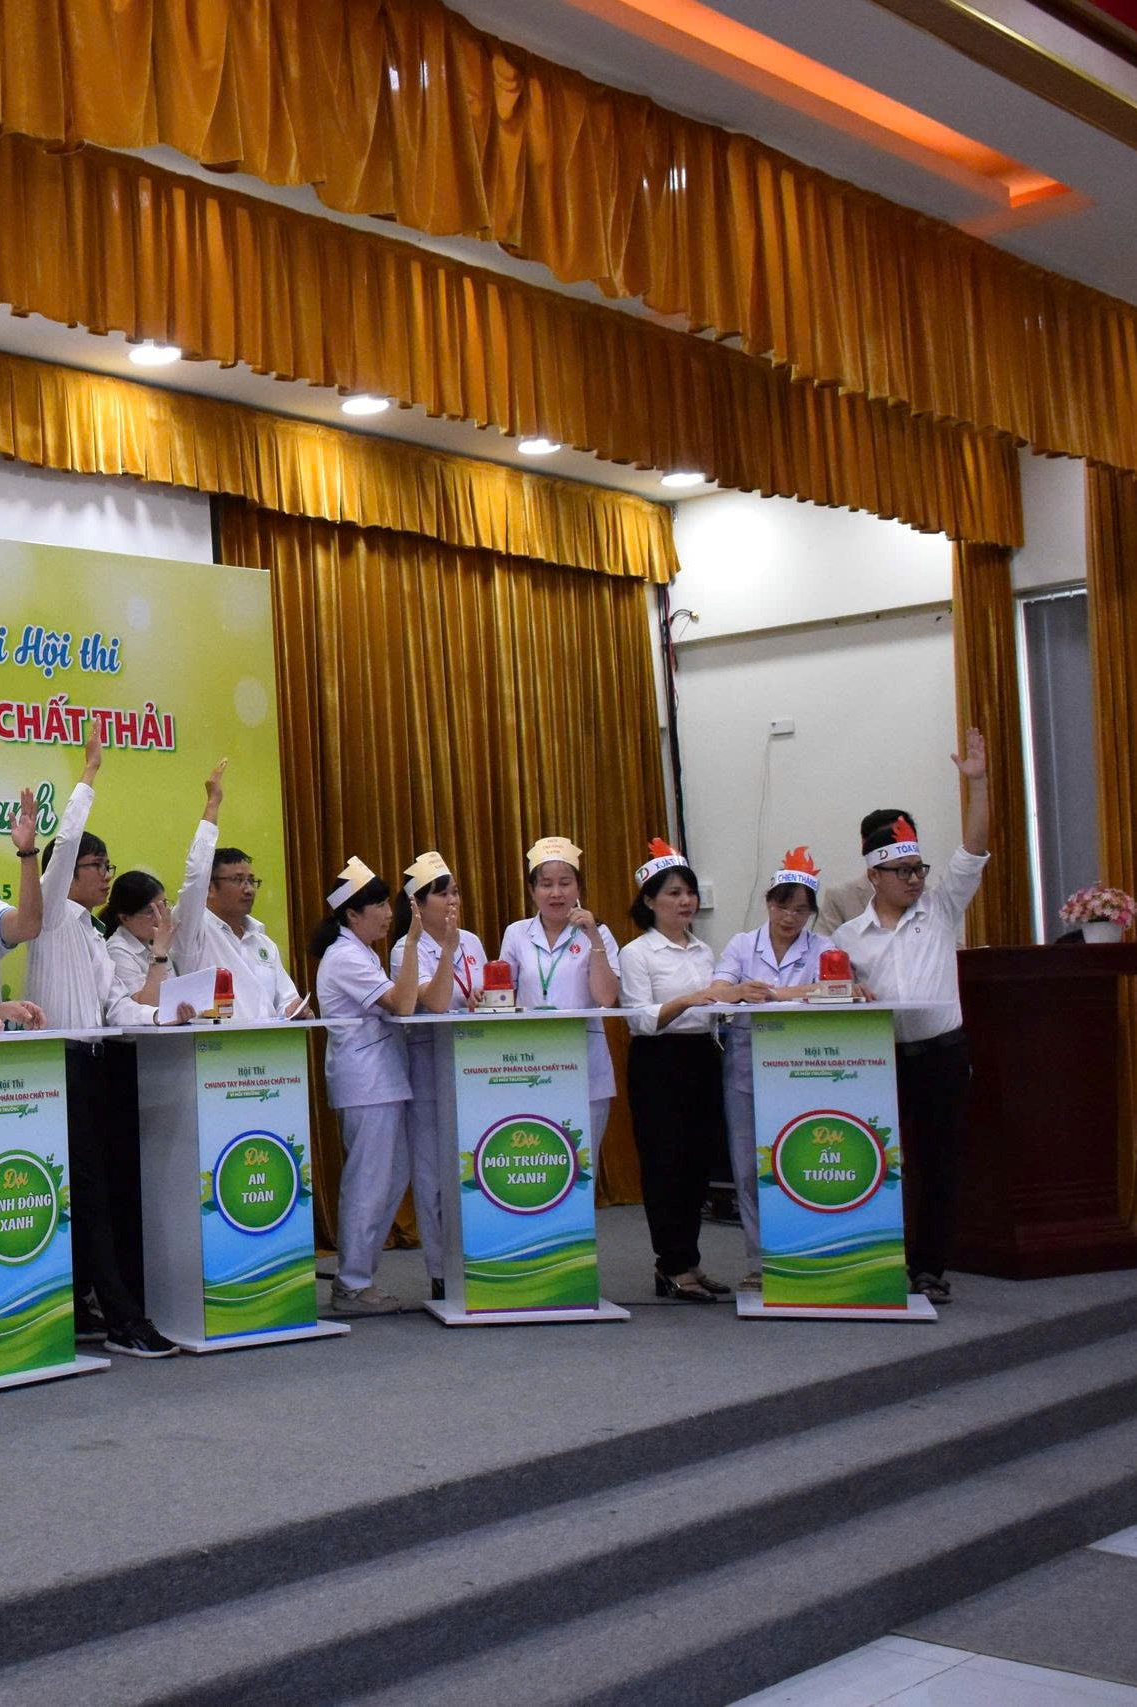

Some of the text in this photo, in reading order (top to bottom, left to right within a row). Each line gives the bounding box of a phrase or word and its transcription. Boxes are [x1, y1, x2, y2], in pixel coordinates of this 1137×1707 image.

[15, 625, 72, 678] Hội
[79, 633, 120, 672] thi
[92, 702, 174, 748] THẢI
[484, 1151, 568, 1168] MÔI TRƯỜNG
[818, 1147, 841, 1163] ẤN
[248, 1173, 266, 1185] AN
[507, 1172, 547, 1184] XANH
[803, 1168, 856, 1183] TƯỢNG
[17, 1192, 52, 1212] ĐỘNG
[242, 1187, 274, 1204] TOÀN
[0, 1215, 34, 1232] XANH
